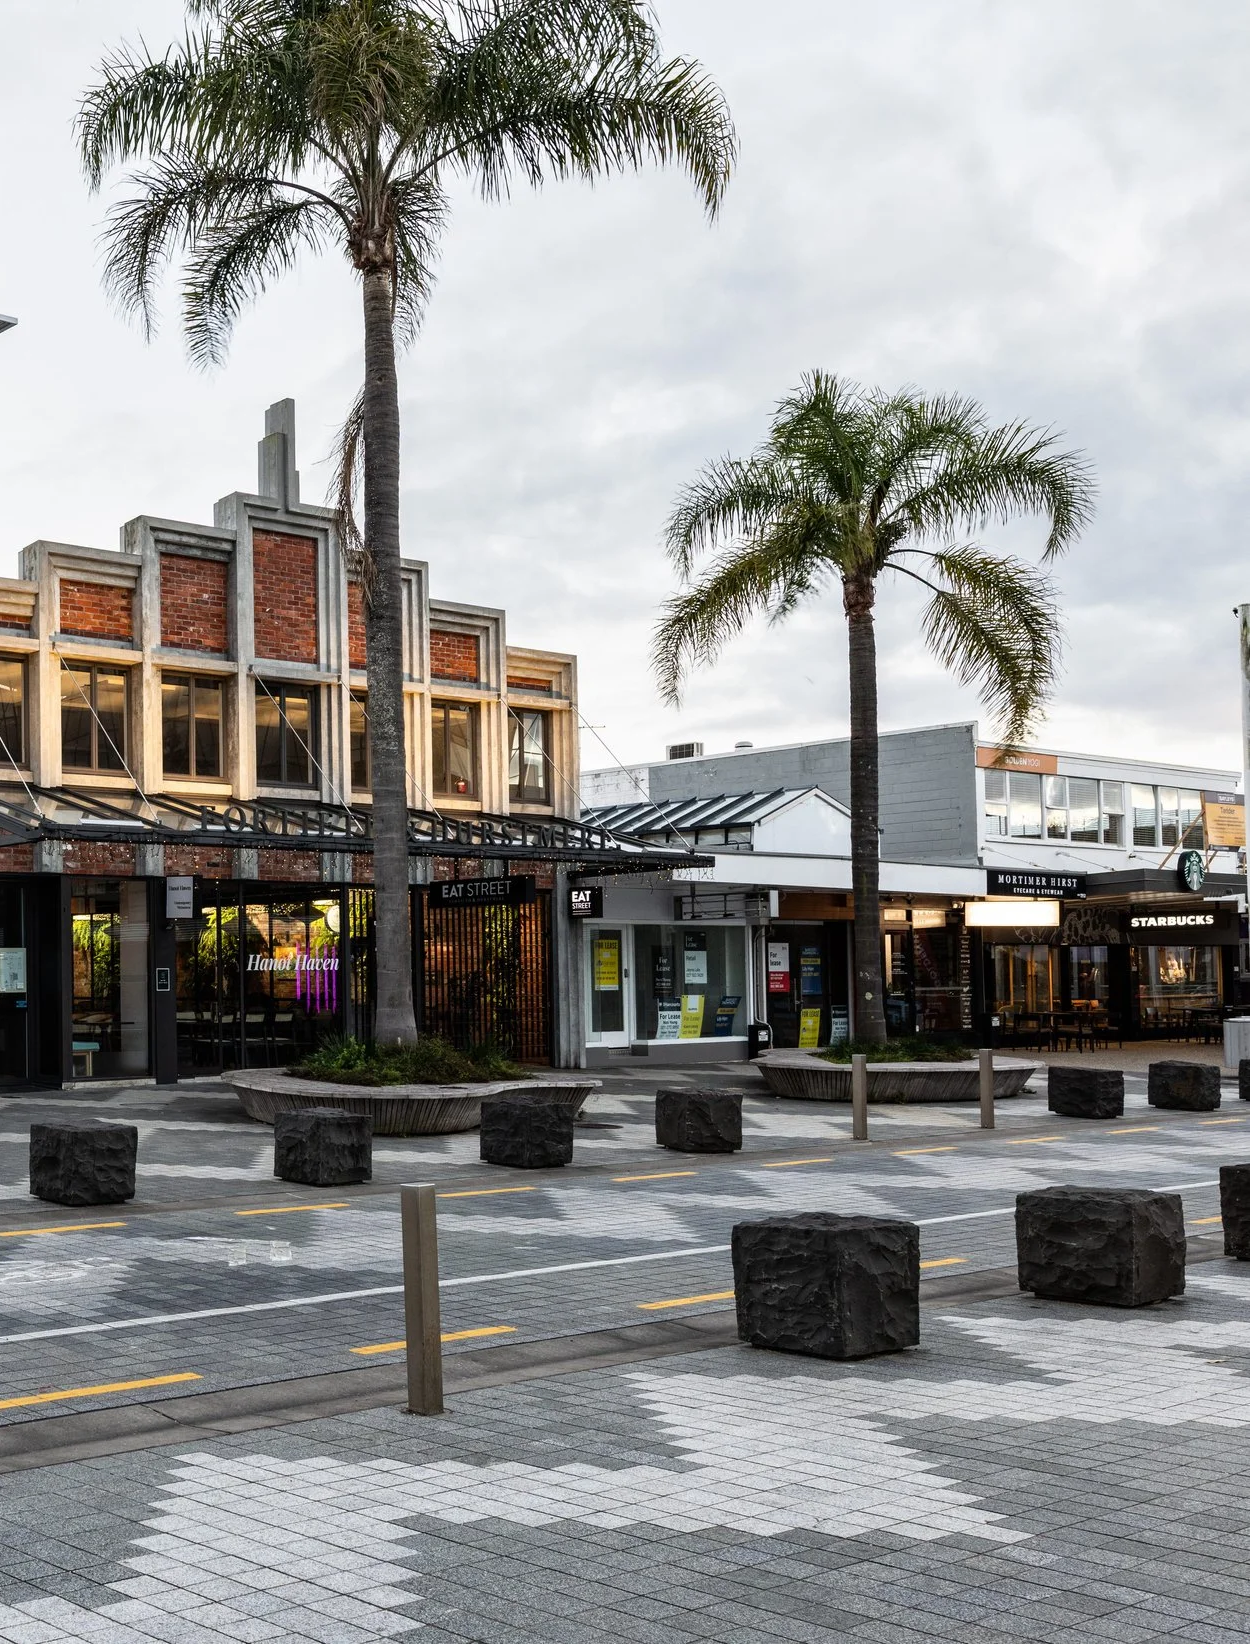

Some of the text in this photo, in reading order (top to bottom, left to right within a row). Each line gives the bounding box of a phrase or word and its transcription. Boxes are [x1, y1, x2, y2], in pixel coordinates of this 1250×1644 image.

[199, 805, 373, 840] FORTIETH
[430, 818, 621, 850] HURSTMERE
[998, 874, 1078, 888] MORTIMER HIRST
[442, 880, 512, 898] EAT STREET
[571, 890, 591, 902] EAT
[571, 902, 592, 910] STREET
[1131, 915, 1214, 927] STARBUCKS
[604, 941, 618, 950] LEASE
[246, 952, 339, 971] Hanoi Haven
[658, 956, 668, 964] For
[656, 963, 670, 971] Lease
